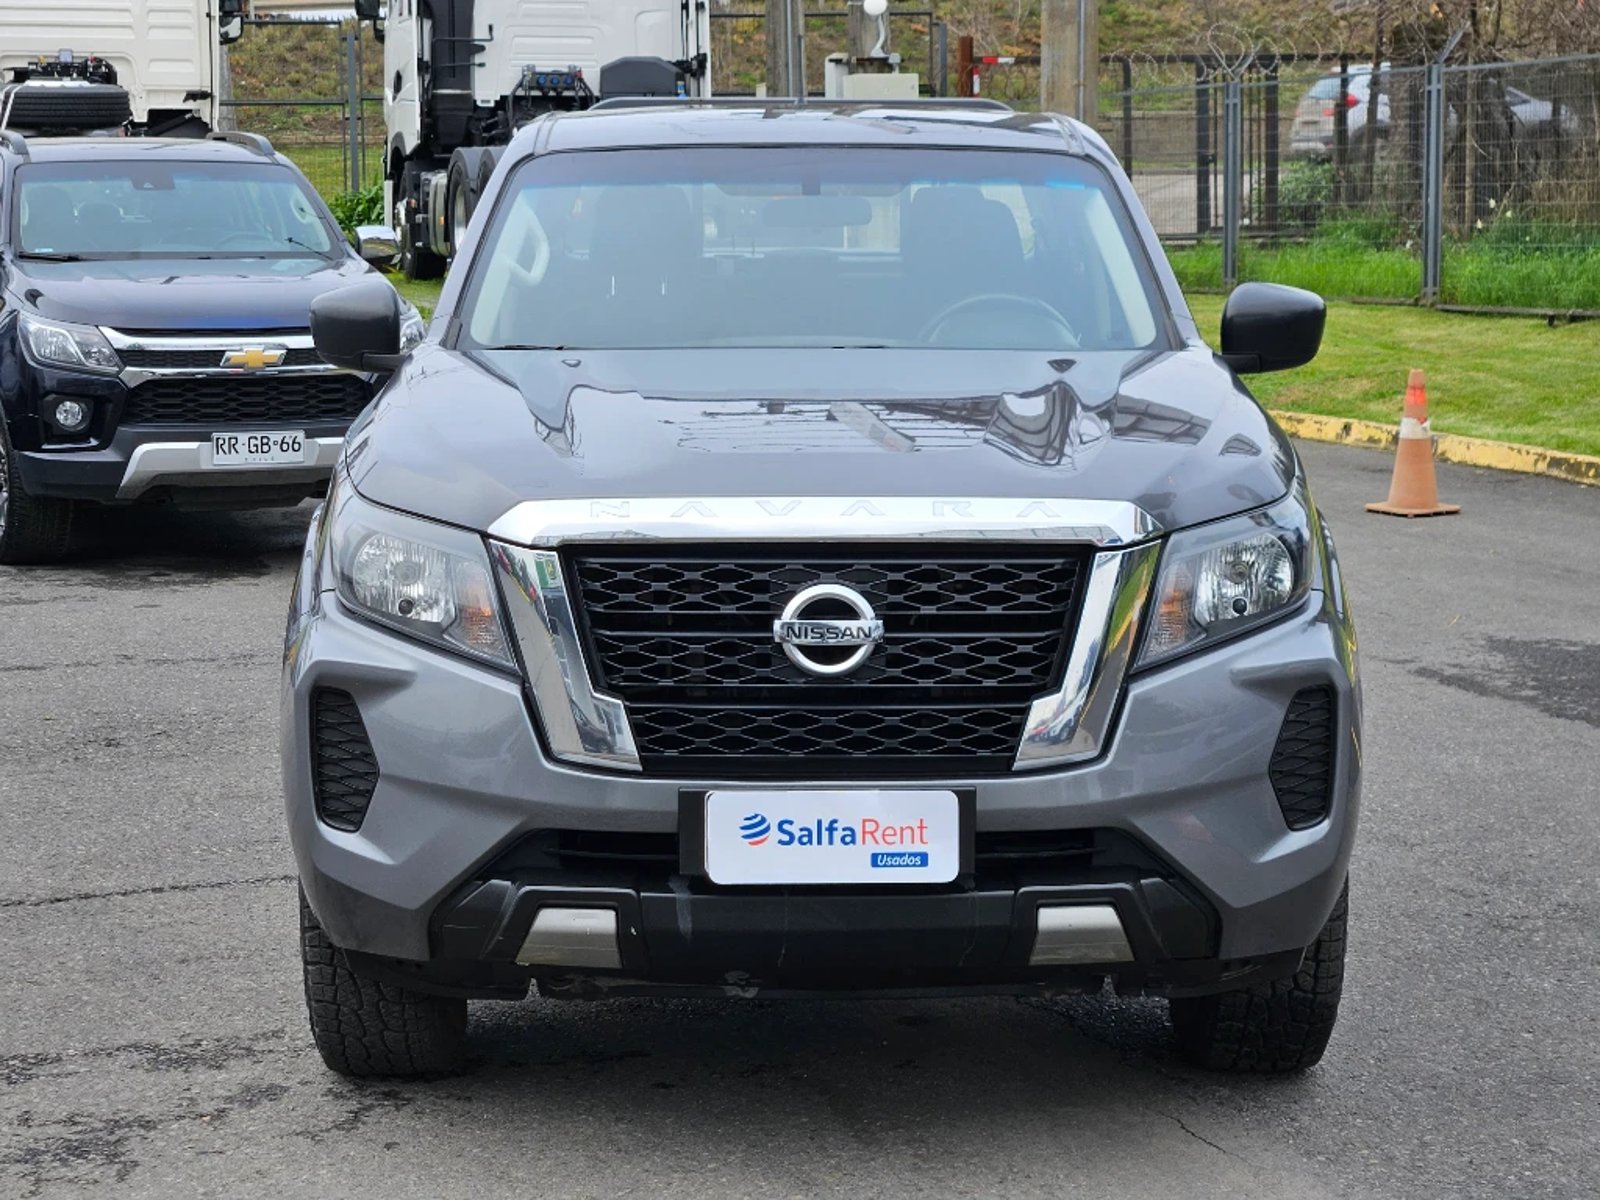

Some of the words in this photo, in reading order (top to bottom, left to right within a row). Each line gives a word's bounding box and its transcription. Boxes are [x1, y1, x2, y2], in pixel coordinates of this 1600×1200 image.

[590, 500, 1061, 518] NAVARA
[786, 626, 872, 639] NISSAN
[877, 854, 921, 866] Usados
